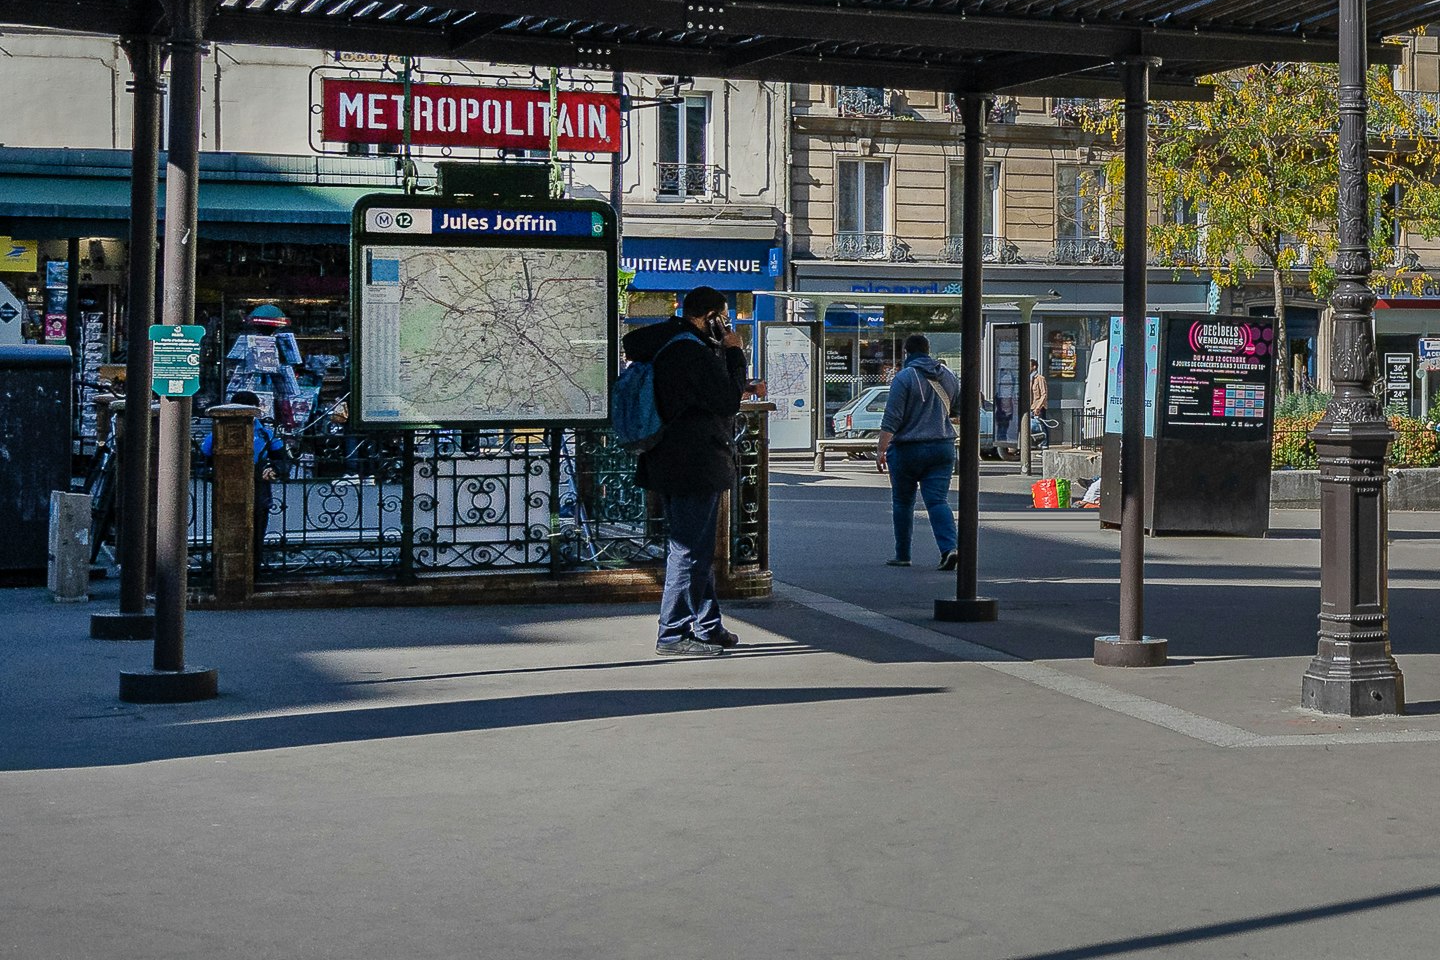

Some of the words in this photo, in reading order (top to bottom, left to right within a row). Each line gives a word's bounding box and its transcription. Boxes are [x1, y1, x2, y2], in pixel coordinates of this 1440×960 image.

[338, 92, 607, 139] METROPOLITAIN
[397, 215, 411, 226] 12
[440, 213, 489, 230] Jules
[494, 214, 557, 232] Joffrin
[621, 256, 692, 271] UITIÈME
[695, 258, 760, 272] AVENUE
[1197, 336, 1243, 346] VENDANGES
